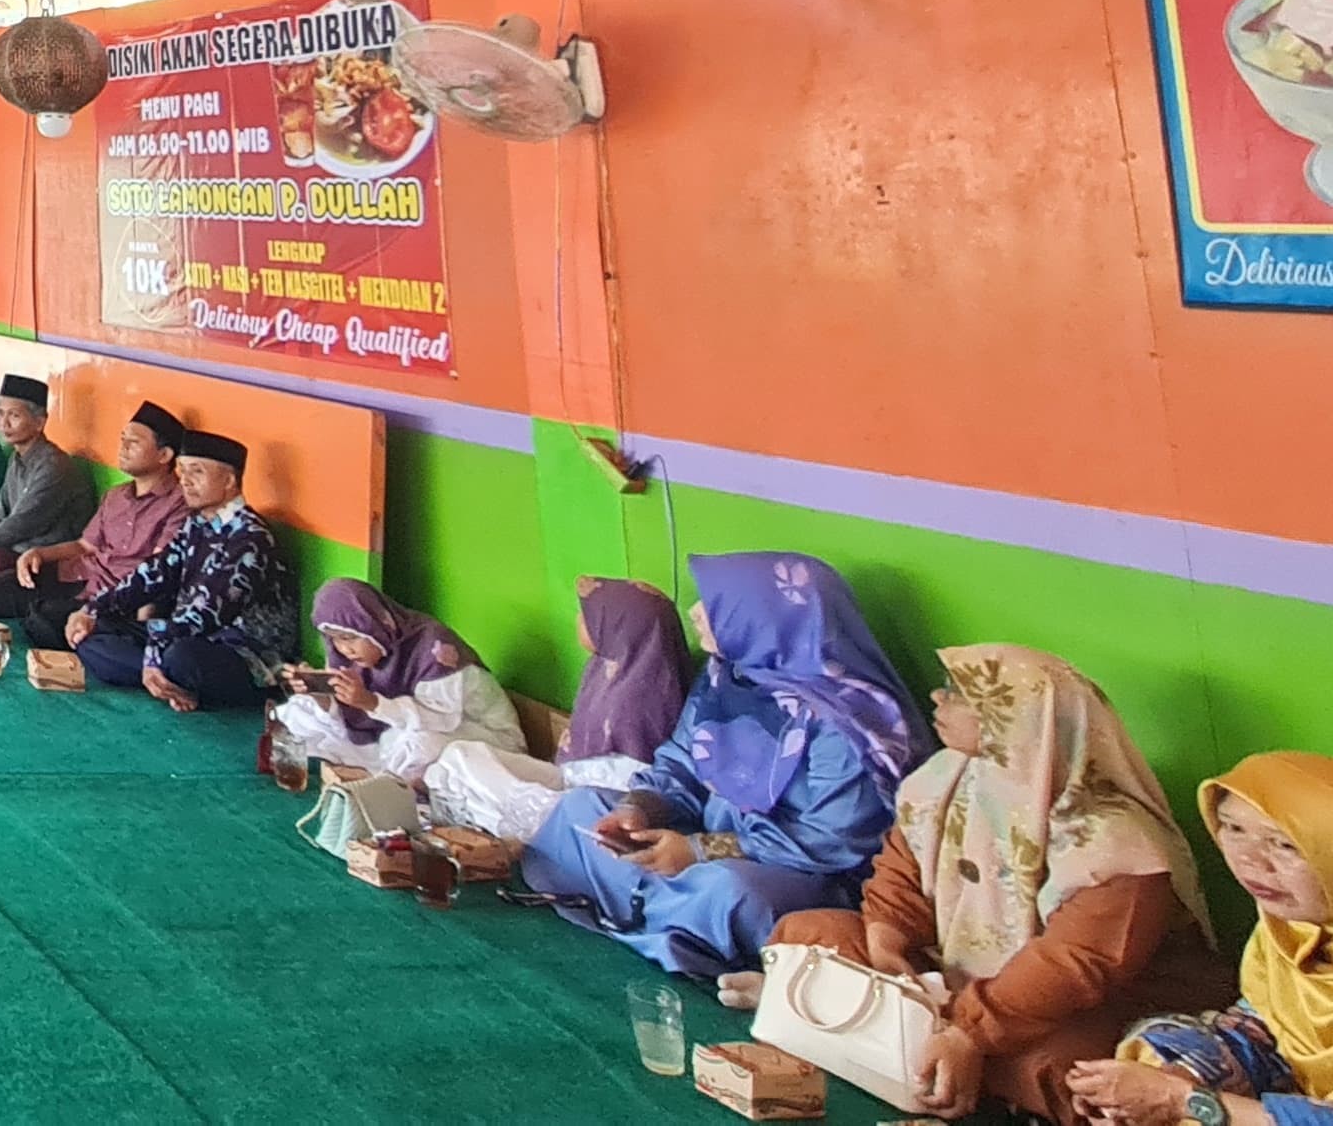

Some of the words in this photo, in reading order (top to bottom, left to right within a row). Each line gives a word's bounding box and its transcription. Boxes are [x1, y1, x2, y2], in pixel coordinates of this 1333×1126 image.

[108, 41, 155, 79] DISINI
[160, 33, 210, 74] AKAN
[212, 20, 295, 65] SEGERA
[299, 4, 397, 55] DIBUKA
[141, 95, 181, 121] MENU
[183, 91, 220, 118] PAGI
[108, 134, 136, 157] JAM
[139, 128, 230, 156] 06.00-11.00
[233, 127, 270, 153] WIB
[108, 180, 154, 214] SOTO
[157, 180, 275, 218] LAMONGAN
[279, 180, 306, 220] P.
[308, 179, 421, 221] DULLAH
[267, 239, 326, 264] LENGKAP
[1205, 238, 1333, 287] Delicious
[122, 256, 169, 296] 10K
[184, 261, 212, 289] SOTO
[221, 264, 250, 294] NASI
[260, 268, 282, 297] TEH
[358, 276, 432, 313] MENDOAN
[434, 282, 447, 314] 2
[276, 308, 339, 355] Cheap
[345, 316, 450, 367] Qualified
